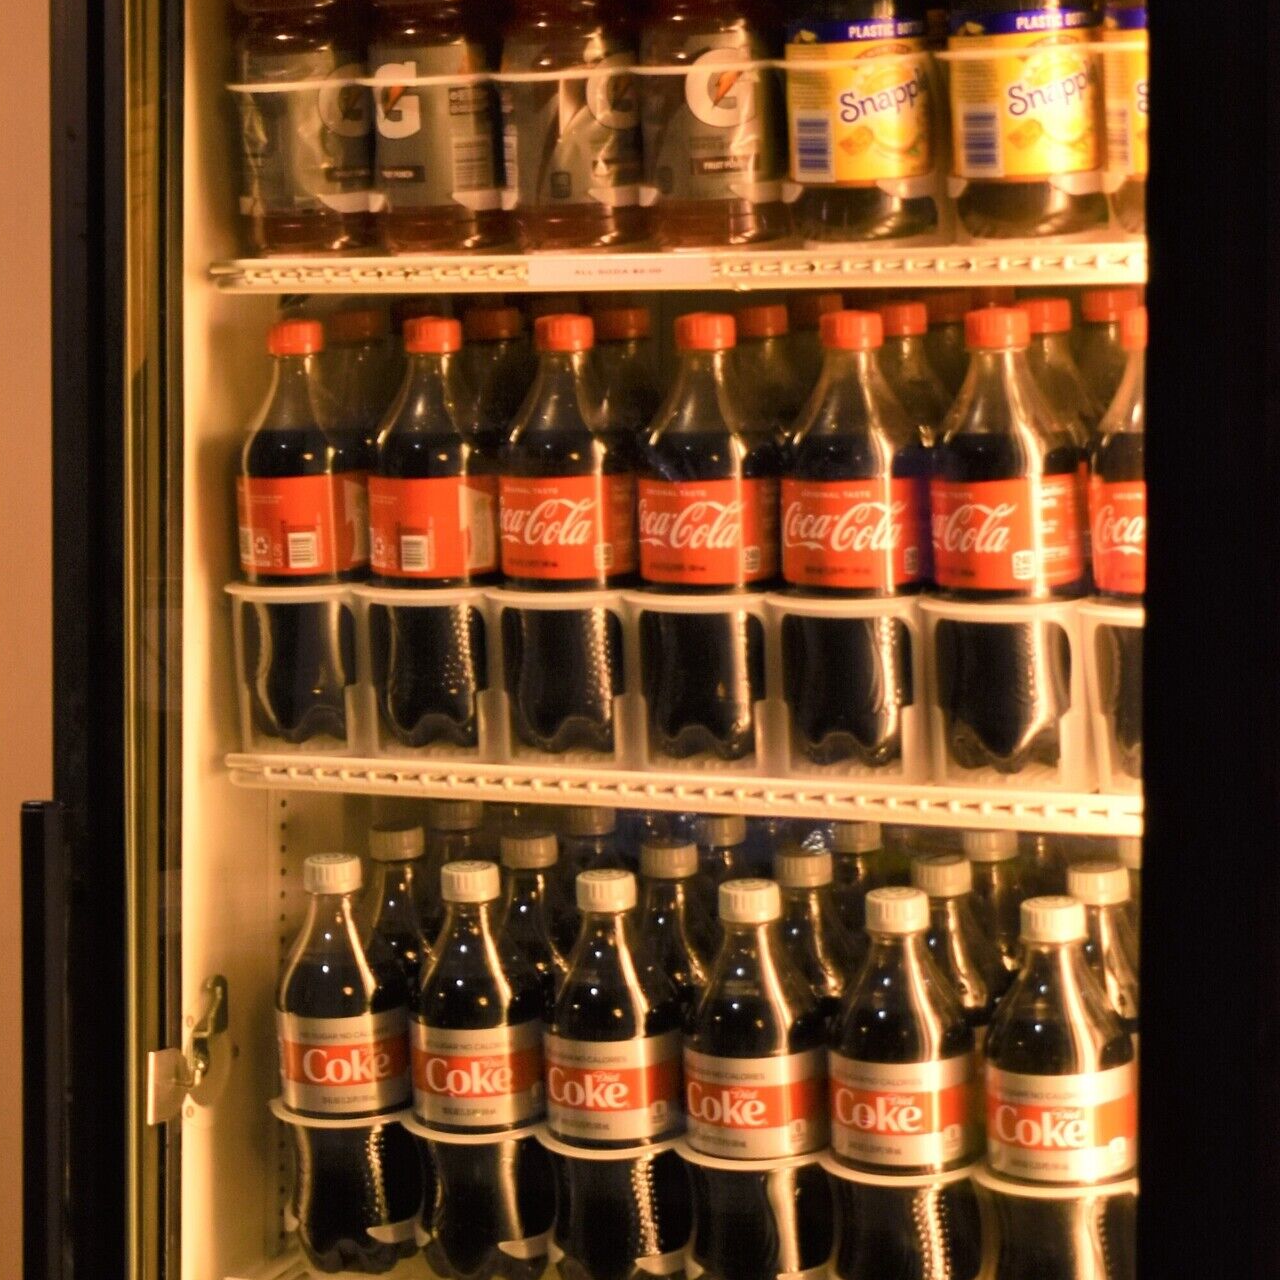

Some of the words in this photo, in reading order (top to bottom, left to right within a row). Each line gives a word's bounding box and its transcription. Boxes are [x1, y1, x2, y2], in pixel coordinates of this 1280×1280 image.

[373, 61, 420, 139] G
[840, 68, 922, 123] Snapp
[1008, 61, 1089, 115] Snapp
[501, 496, 599, 546] ca-Cola
[784, 501, 907, 553] Coca-Cola
[303, 1048, 391, 1083] Coke
[426, 1058, 513, 1095] Coke
[548, 1067, 629, 1108] Coke
[687, 1082, 768, 1126] Coke
[835, 1088, 922, 1133] Coke
[996, 1105, 1090, 1148] Coke
